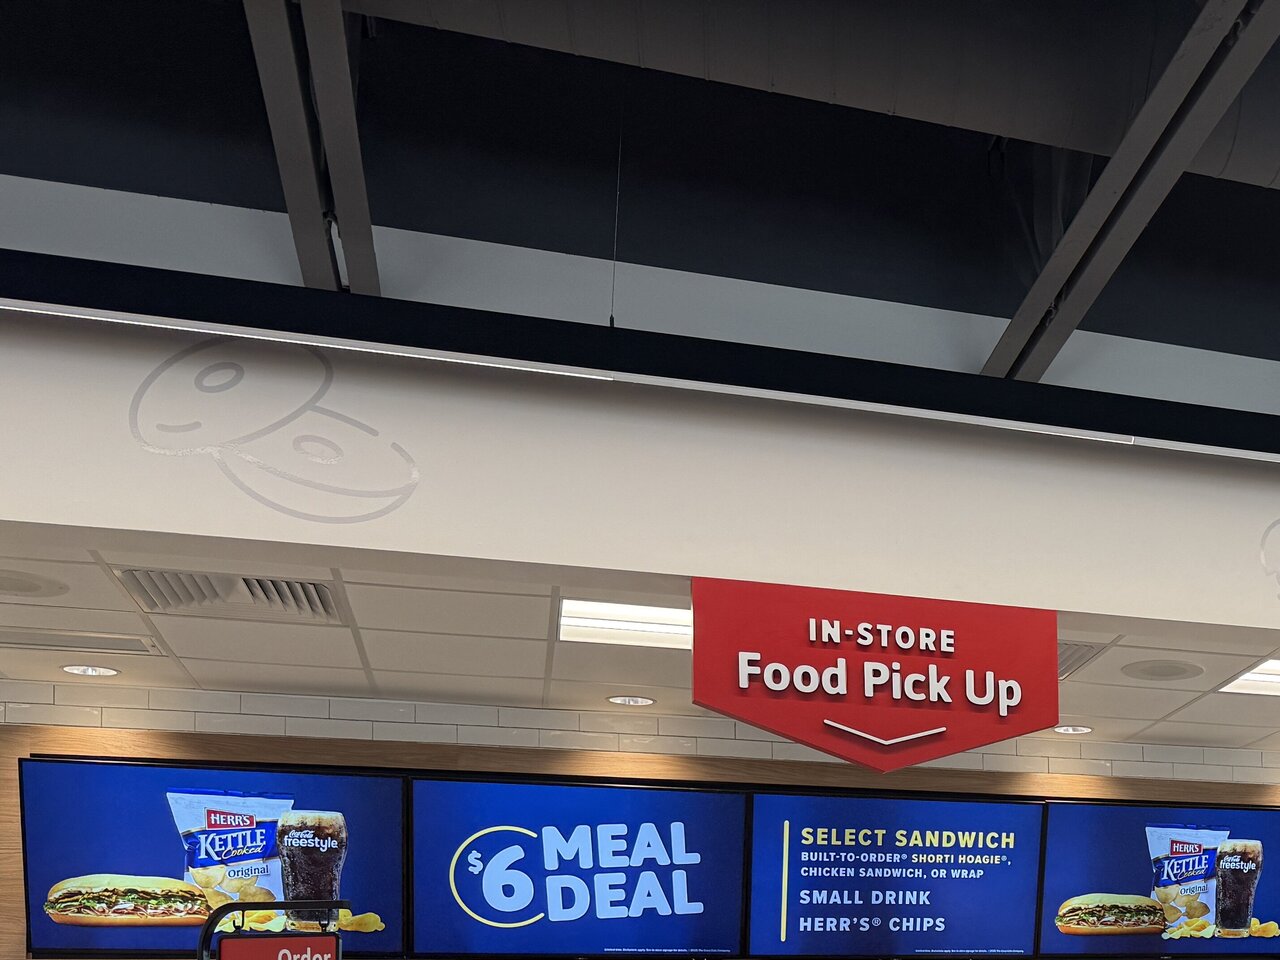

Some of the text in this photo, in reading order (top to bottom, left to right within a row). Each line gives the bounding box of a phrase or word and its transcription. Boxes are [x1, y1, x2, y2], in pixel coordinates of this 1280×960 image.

[809, 617, 955, 653] IN-STORE
[738, 651, 1022, 716] Food Pick Up
[210, 813, 251, 826] HERR'S
[198, 829, 266, 860] KETTLE
[284, 836, 338, 852] freestyle
[801, 828, 1015, 849] SELECT SANDWICH
[222, 844, 263, 860] Cooked
[911, 853, 954, 863] SHORTI
[228, 864, 269, 878] Original
[467, 822, 701, 912] $6 MEAL
[801, 867, 984, 879] CHICKEN SANDWICH, OR WRAP
[1161, 855, 1209, 881] KETTLE
[1220, 860, 1256, 873] freestyle
[545, 870, 704, 921] DEAL
[799, 889, 931, 905] SMALL DRINK
[1180, 883, 1208, 895] Original
[889, 917, 945, 932] CHIPS
